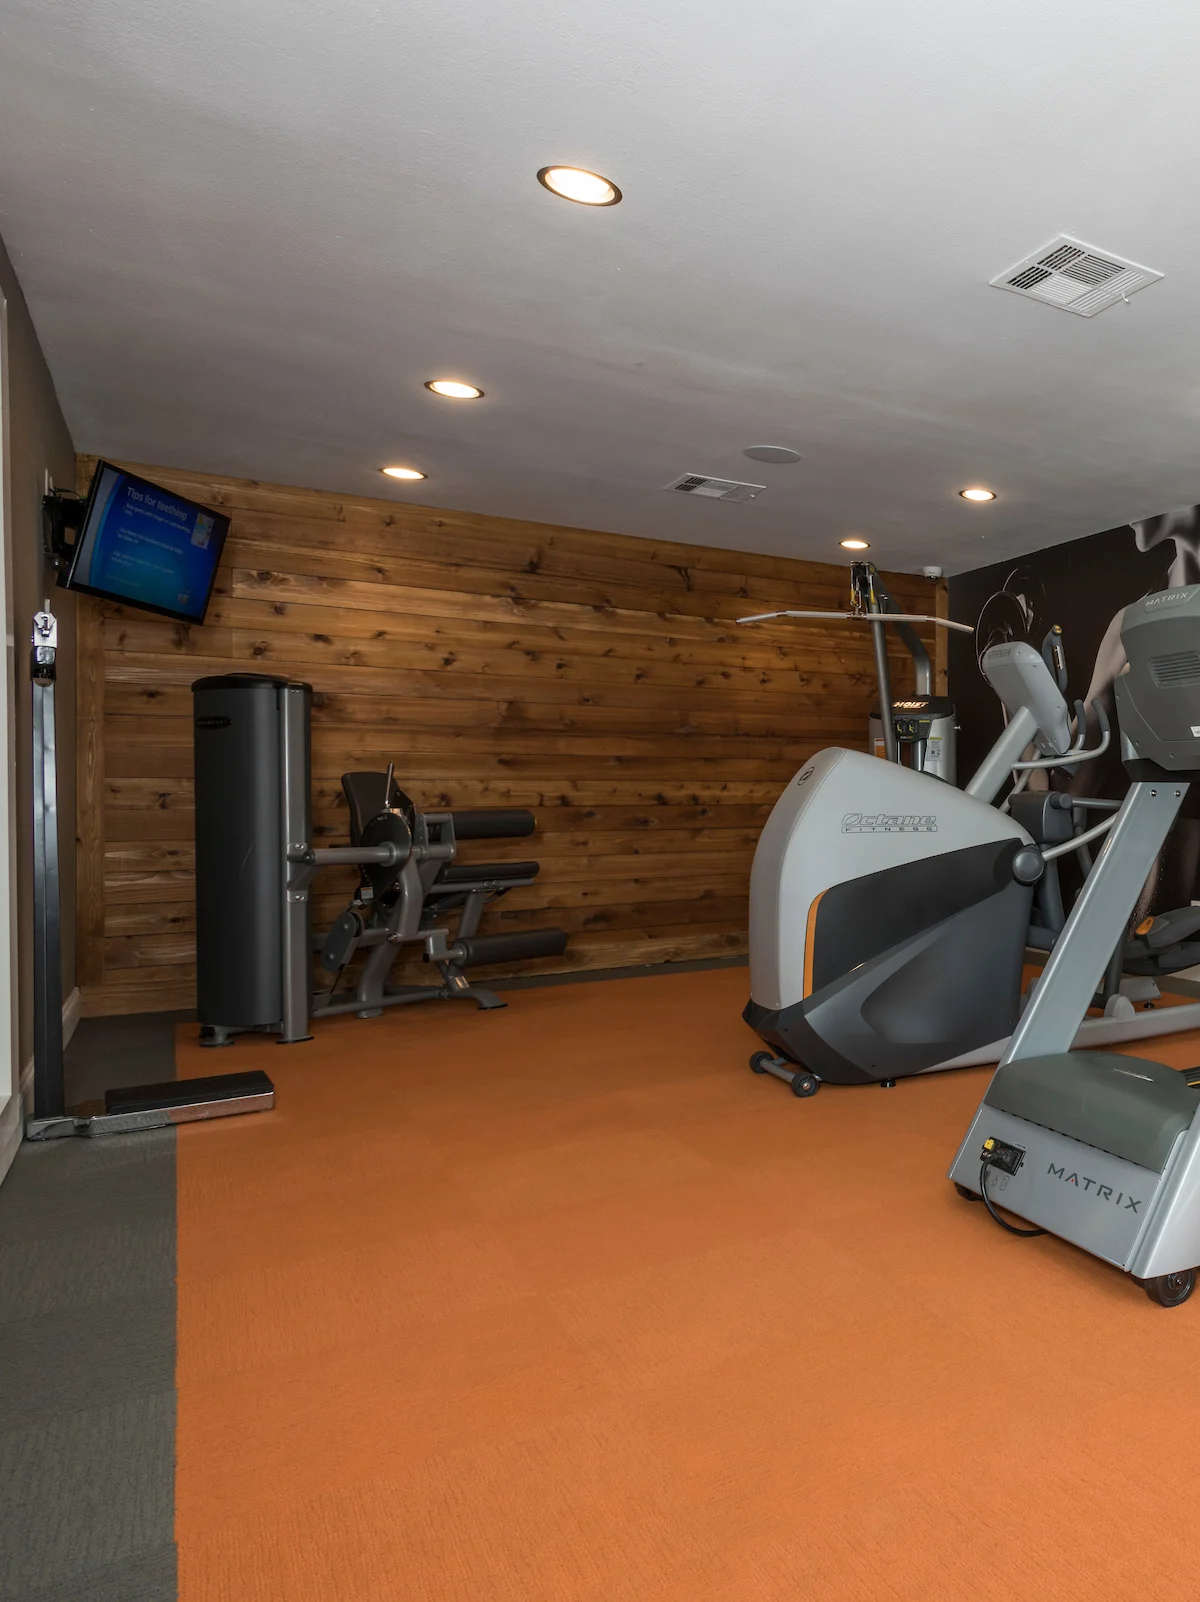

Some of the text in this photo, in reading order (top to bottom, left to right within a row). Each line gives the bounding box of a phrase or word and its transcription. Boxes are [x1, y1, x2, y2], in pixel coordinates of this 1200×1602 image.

[127, 487, 188, 521] Tips for teething
[1145, 591, 1189, 607] MATRIX
[892, 701, 930, 709] HOIST
[841, 813, 937, 826] Octane
[1047, 1163, 1143, 1214] MATRIX
